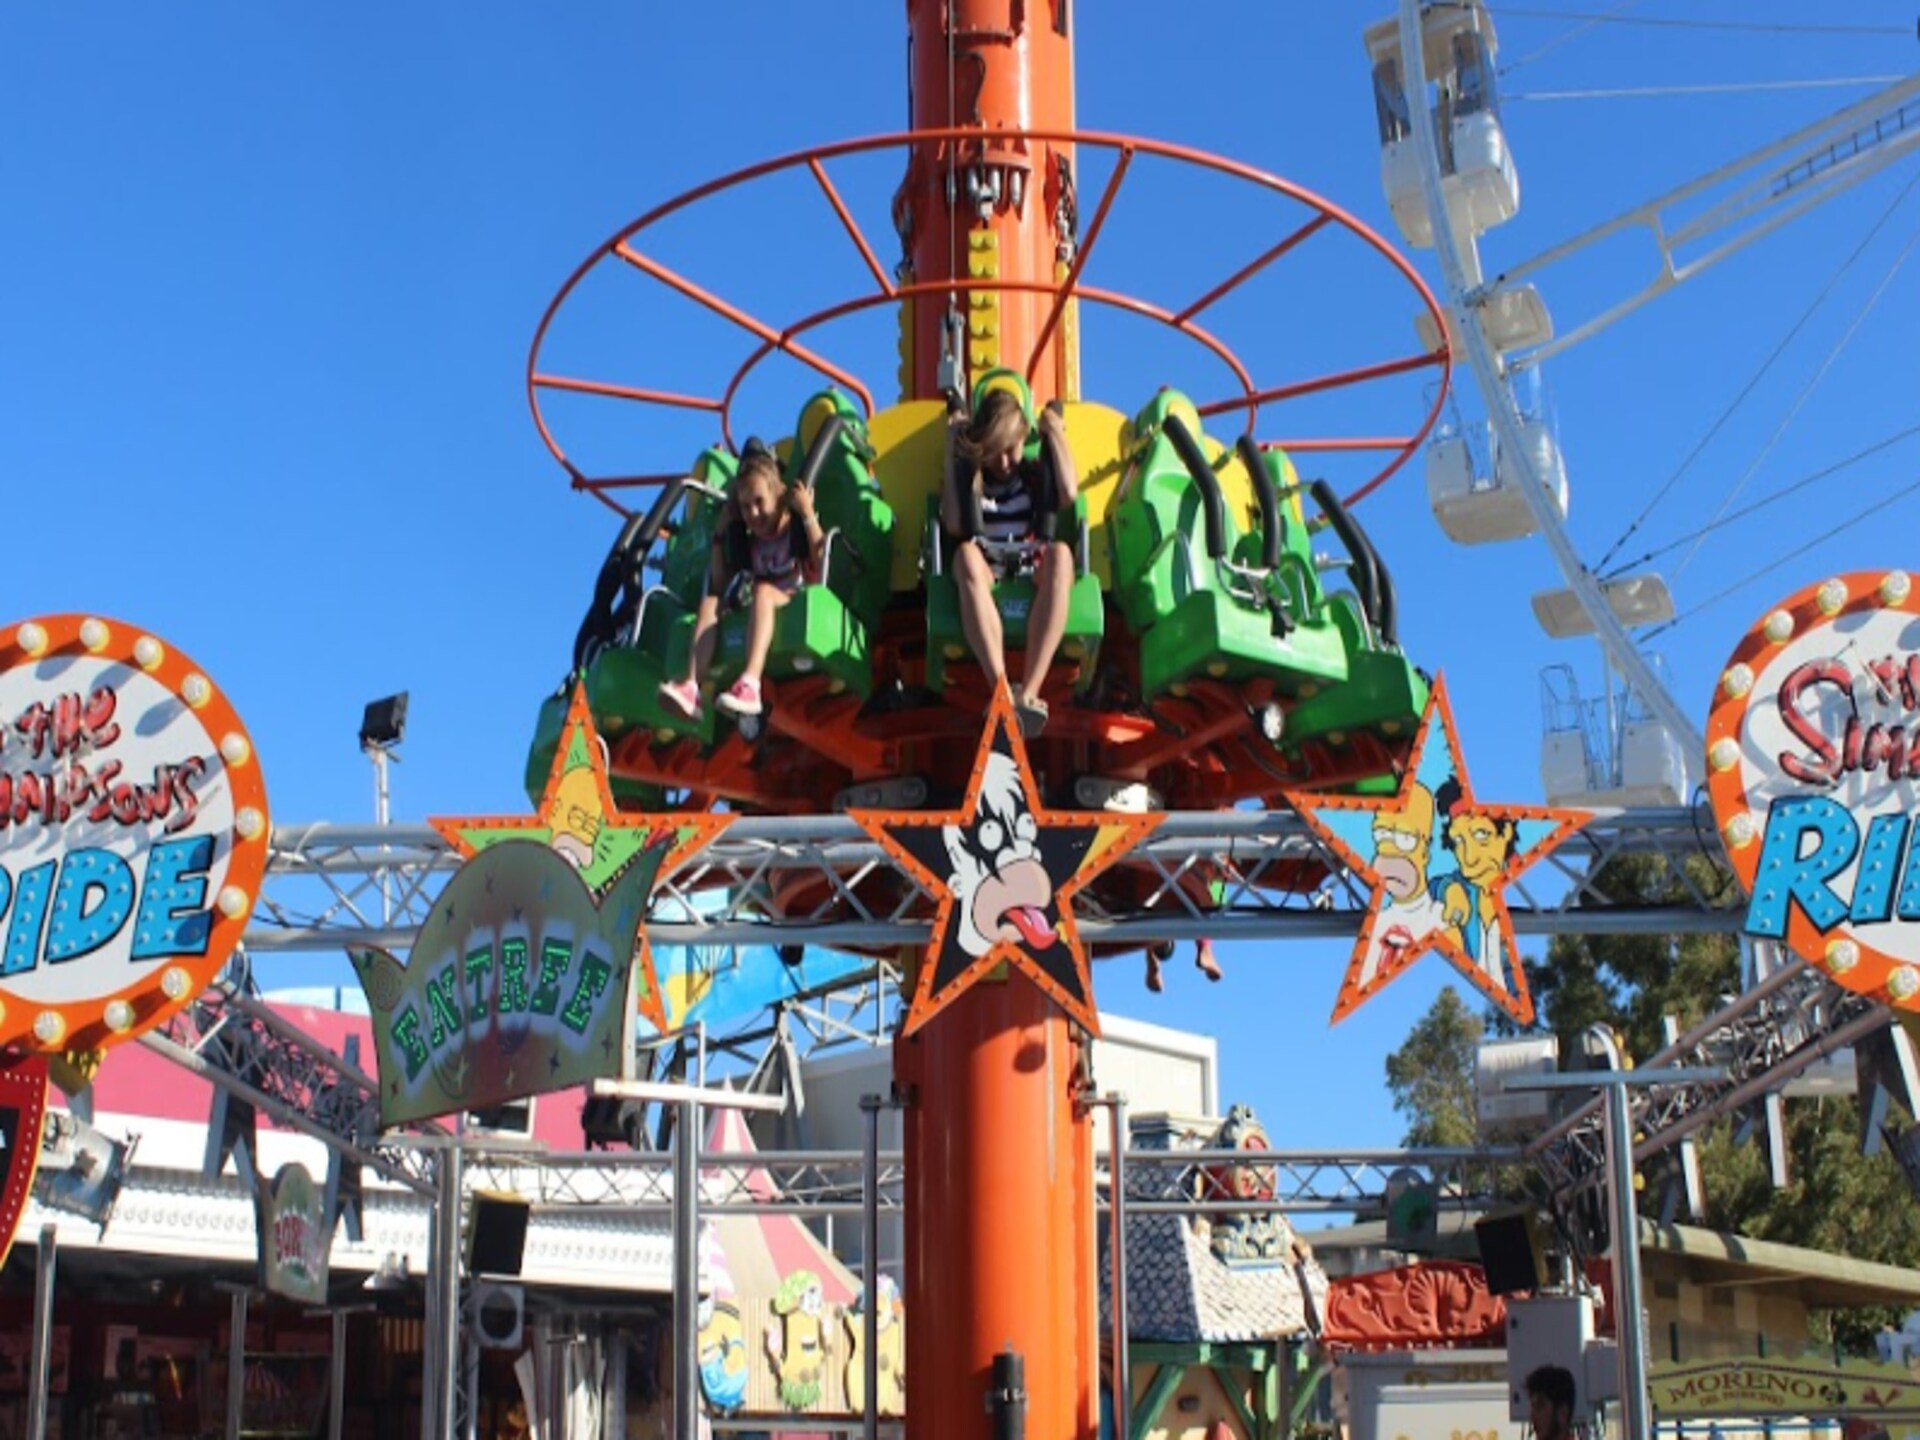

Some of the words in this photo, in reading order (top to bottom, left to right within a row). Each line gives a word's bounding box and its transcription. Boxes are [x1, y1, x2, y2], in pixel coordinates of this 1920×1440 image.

[0, 756, 206, 834] IMPSONS
[0, 834, 215, 975] IDE
[1744, 795, 1920, 938] RI
[391, 937, 612, 1082] ENTREE
[1668, 1370, 1815, 1403] MORENO
